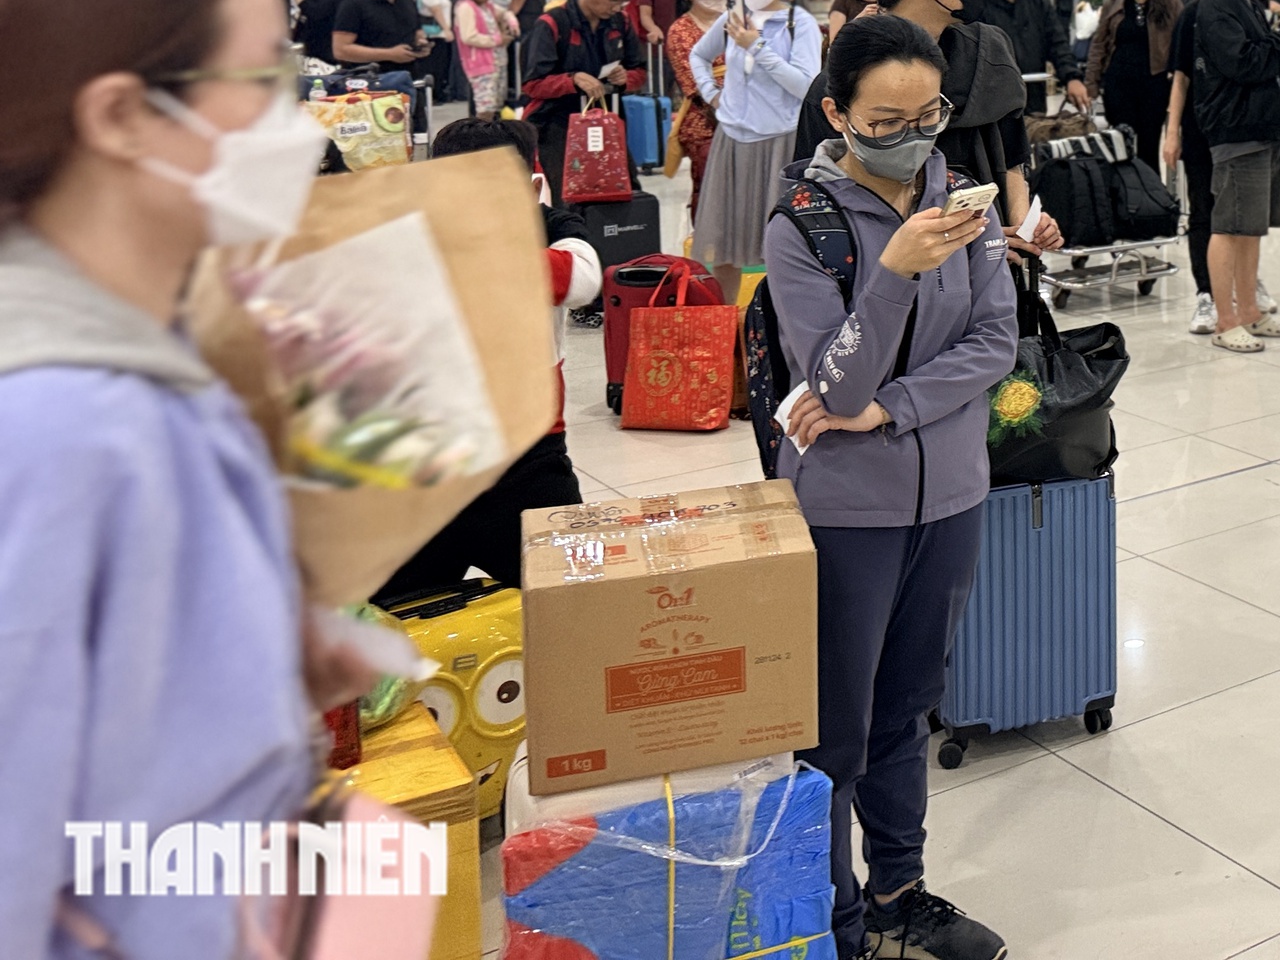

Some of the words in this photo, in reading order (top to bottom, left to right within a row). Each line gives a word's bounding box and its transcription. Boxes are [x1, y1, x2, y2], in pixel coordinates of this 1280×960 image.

[794, 200, 827, 212] SIMPLE
[640, 614, 711, 633] AROMATHERAPY
[562, 760, 569, 771] 1
[572, 757, 593, 772] kg
